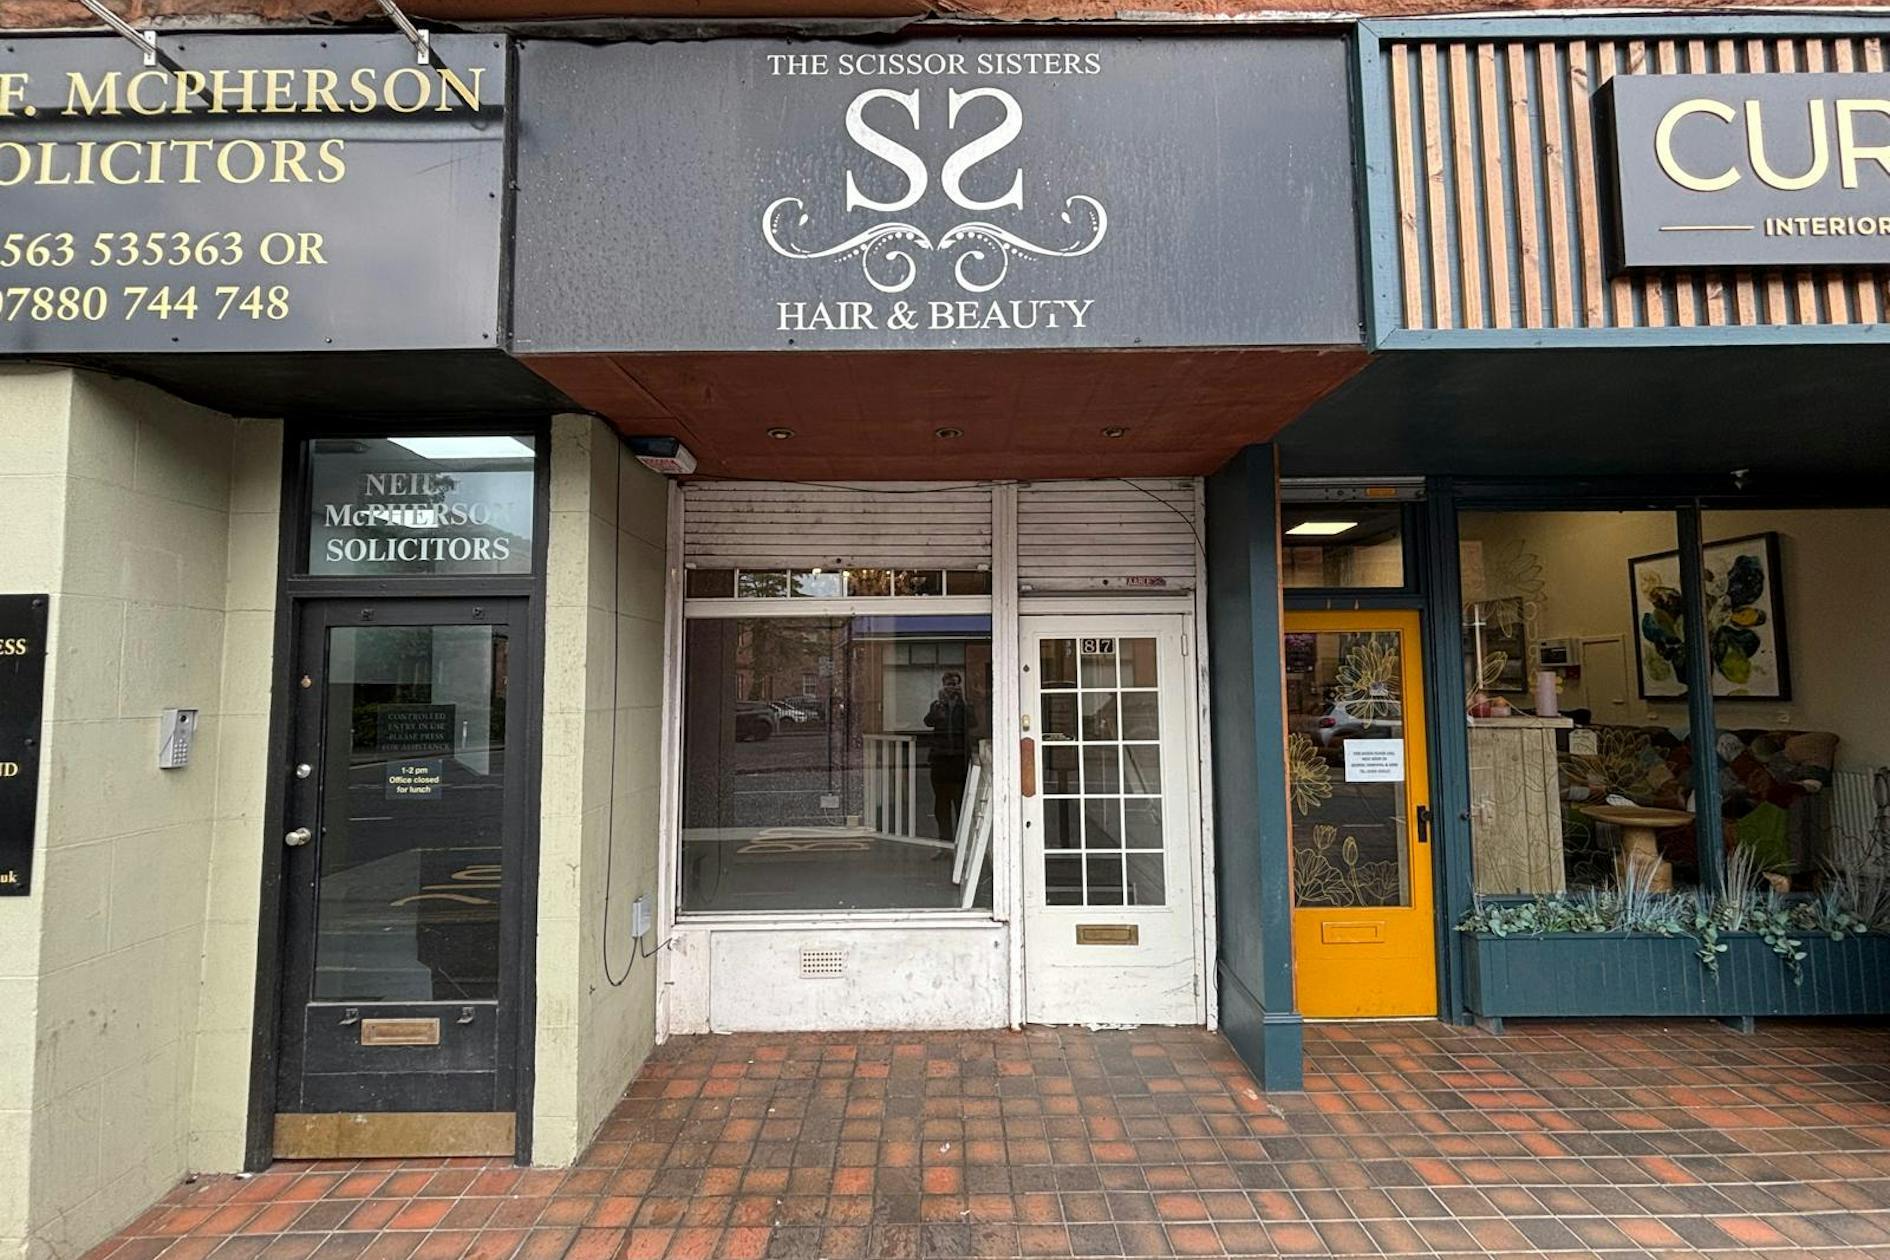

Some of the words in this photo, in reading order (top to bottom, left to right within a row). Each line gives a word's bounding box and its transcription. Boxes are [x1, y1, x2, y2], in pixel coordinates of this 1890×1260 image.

[767, 54, 829, 76] THE
[838, 53, 969, 76] SCISSOR
[977, 52, 1101, 75] SISTERS
[0, 72, 36, 117] F.
[61, 67, 486, 115] MCPHERSON
[90, 231, 243, 266] 535363
[260, 232, 327, 264] OR
[0, 286, 107, 320] 7880
[123, 286, 198, 321] 744
[214, 285, 289, 320] 748
[776, 301, 879, 330] HAIR
[886, 301, 919, 330] &
[927, 300, 1096, 329] BEAUTY
[325, 537, 510, 563] SOLICITORS
[1084, 638, 1111, 654] 87
[388, 776, 412, 784] Office
[413, 776, 440, 784] closed
[401, 766, 414, 775] 1-2
[415, 767, 428, 775] pm
